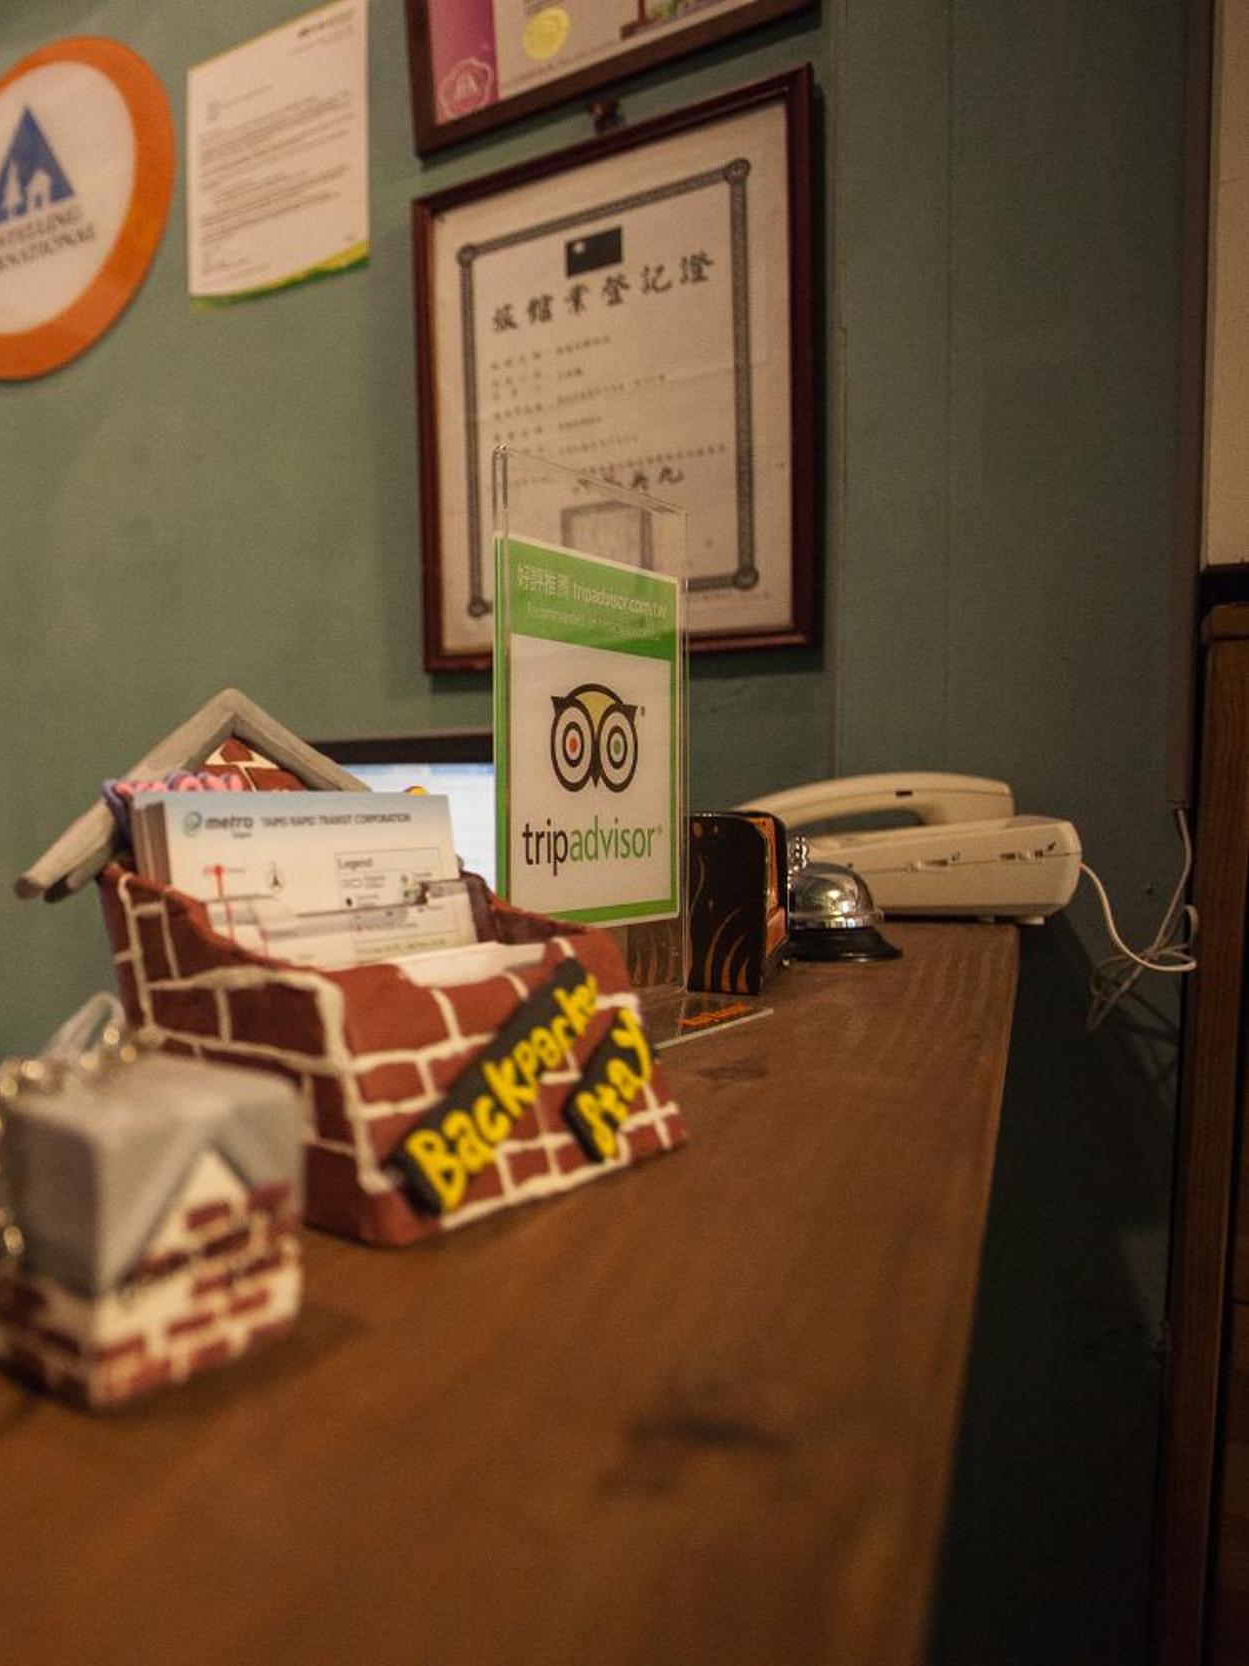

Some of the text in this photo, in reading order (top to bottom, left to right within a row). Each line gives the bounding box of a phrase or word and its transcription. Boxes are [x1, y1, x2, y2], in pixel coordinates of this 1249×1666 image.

[205, 814, 254, 830] metro
[354, 813, 412, 825] CORPORATION
[521, 814, 656, 877] tripadvisor
